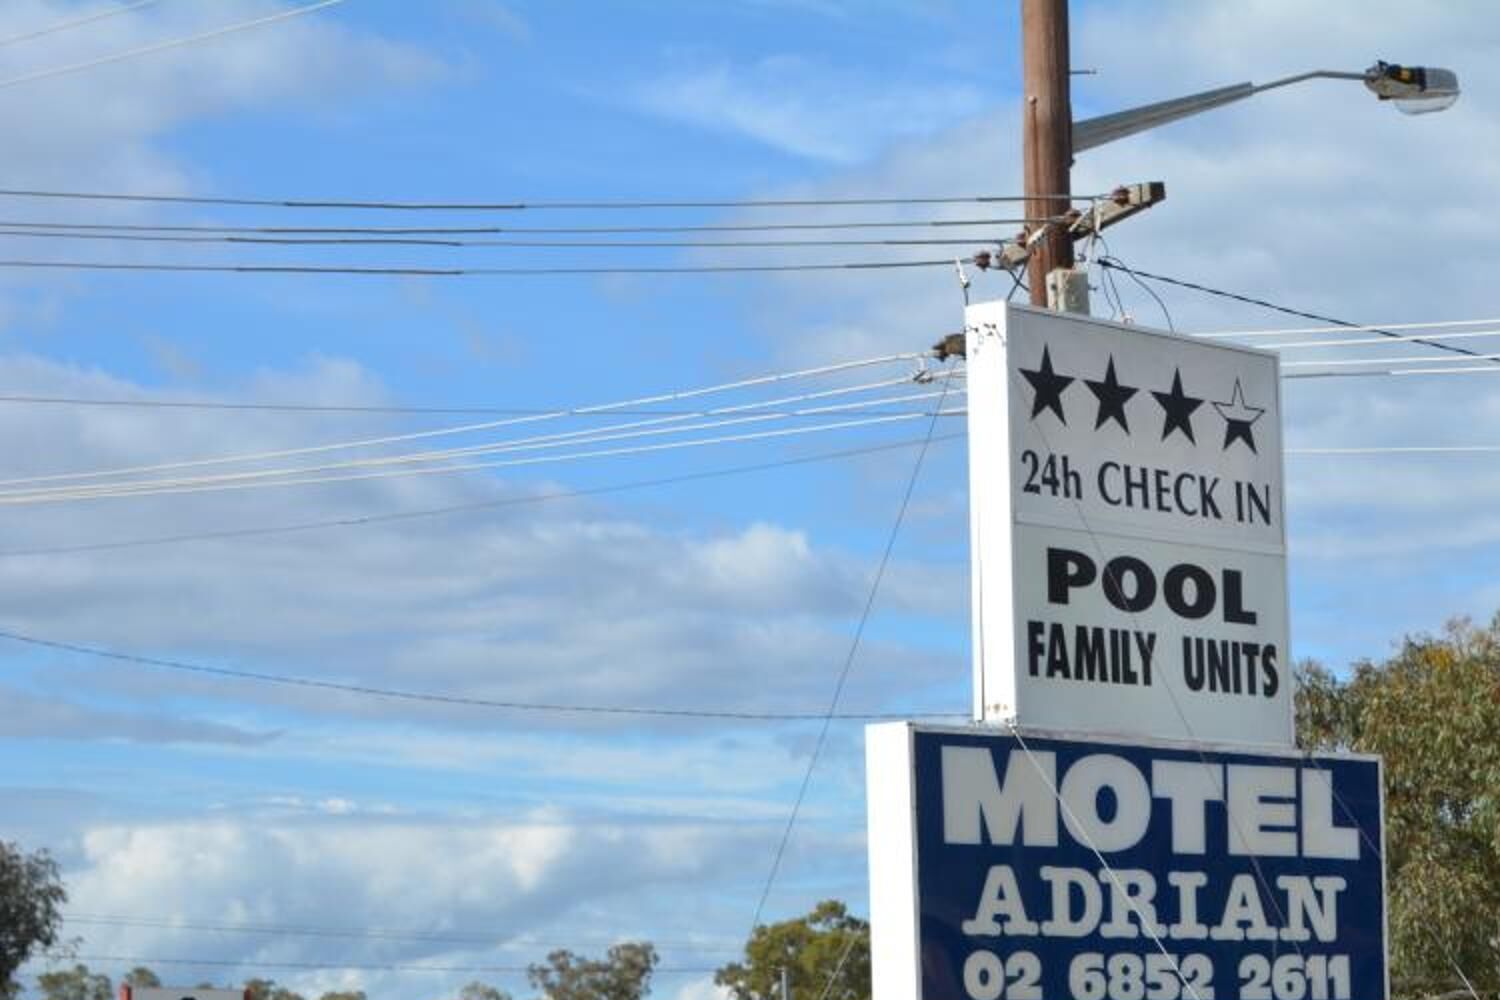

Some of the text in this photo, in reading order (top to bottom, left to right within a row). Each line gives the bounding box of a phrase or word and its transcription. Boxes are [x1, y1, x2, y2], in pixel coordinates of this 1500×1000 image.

[1022, 450, 1272, 527] 24h CHECK IN
[1047, 547, 1258, 626] POOL
[1027, 621, 1279, 699] FAMILY UNITS
[941, 745, 1361, 861] MOTEL
[962, 865, 1347, 943] ADRIAN
